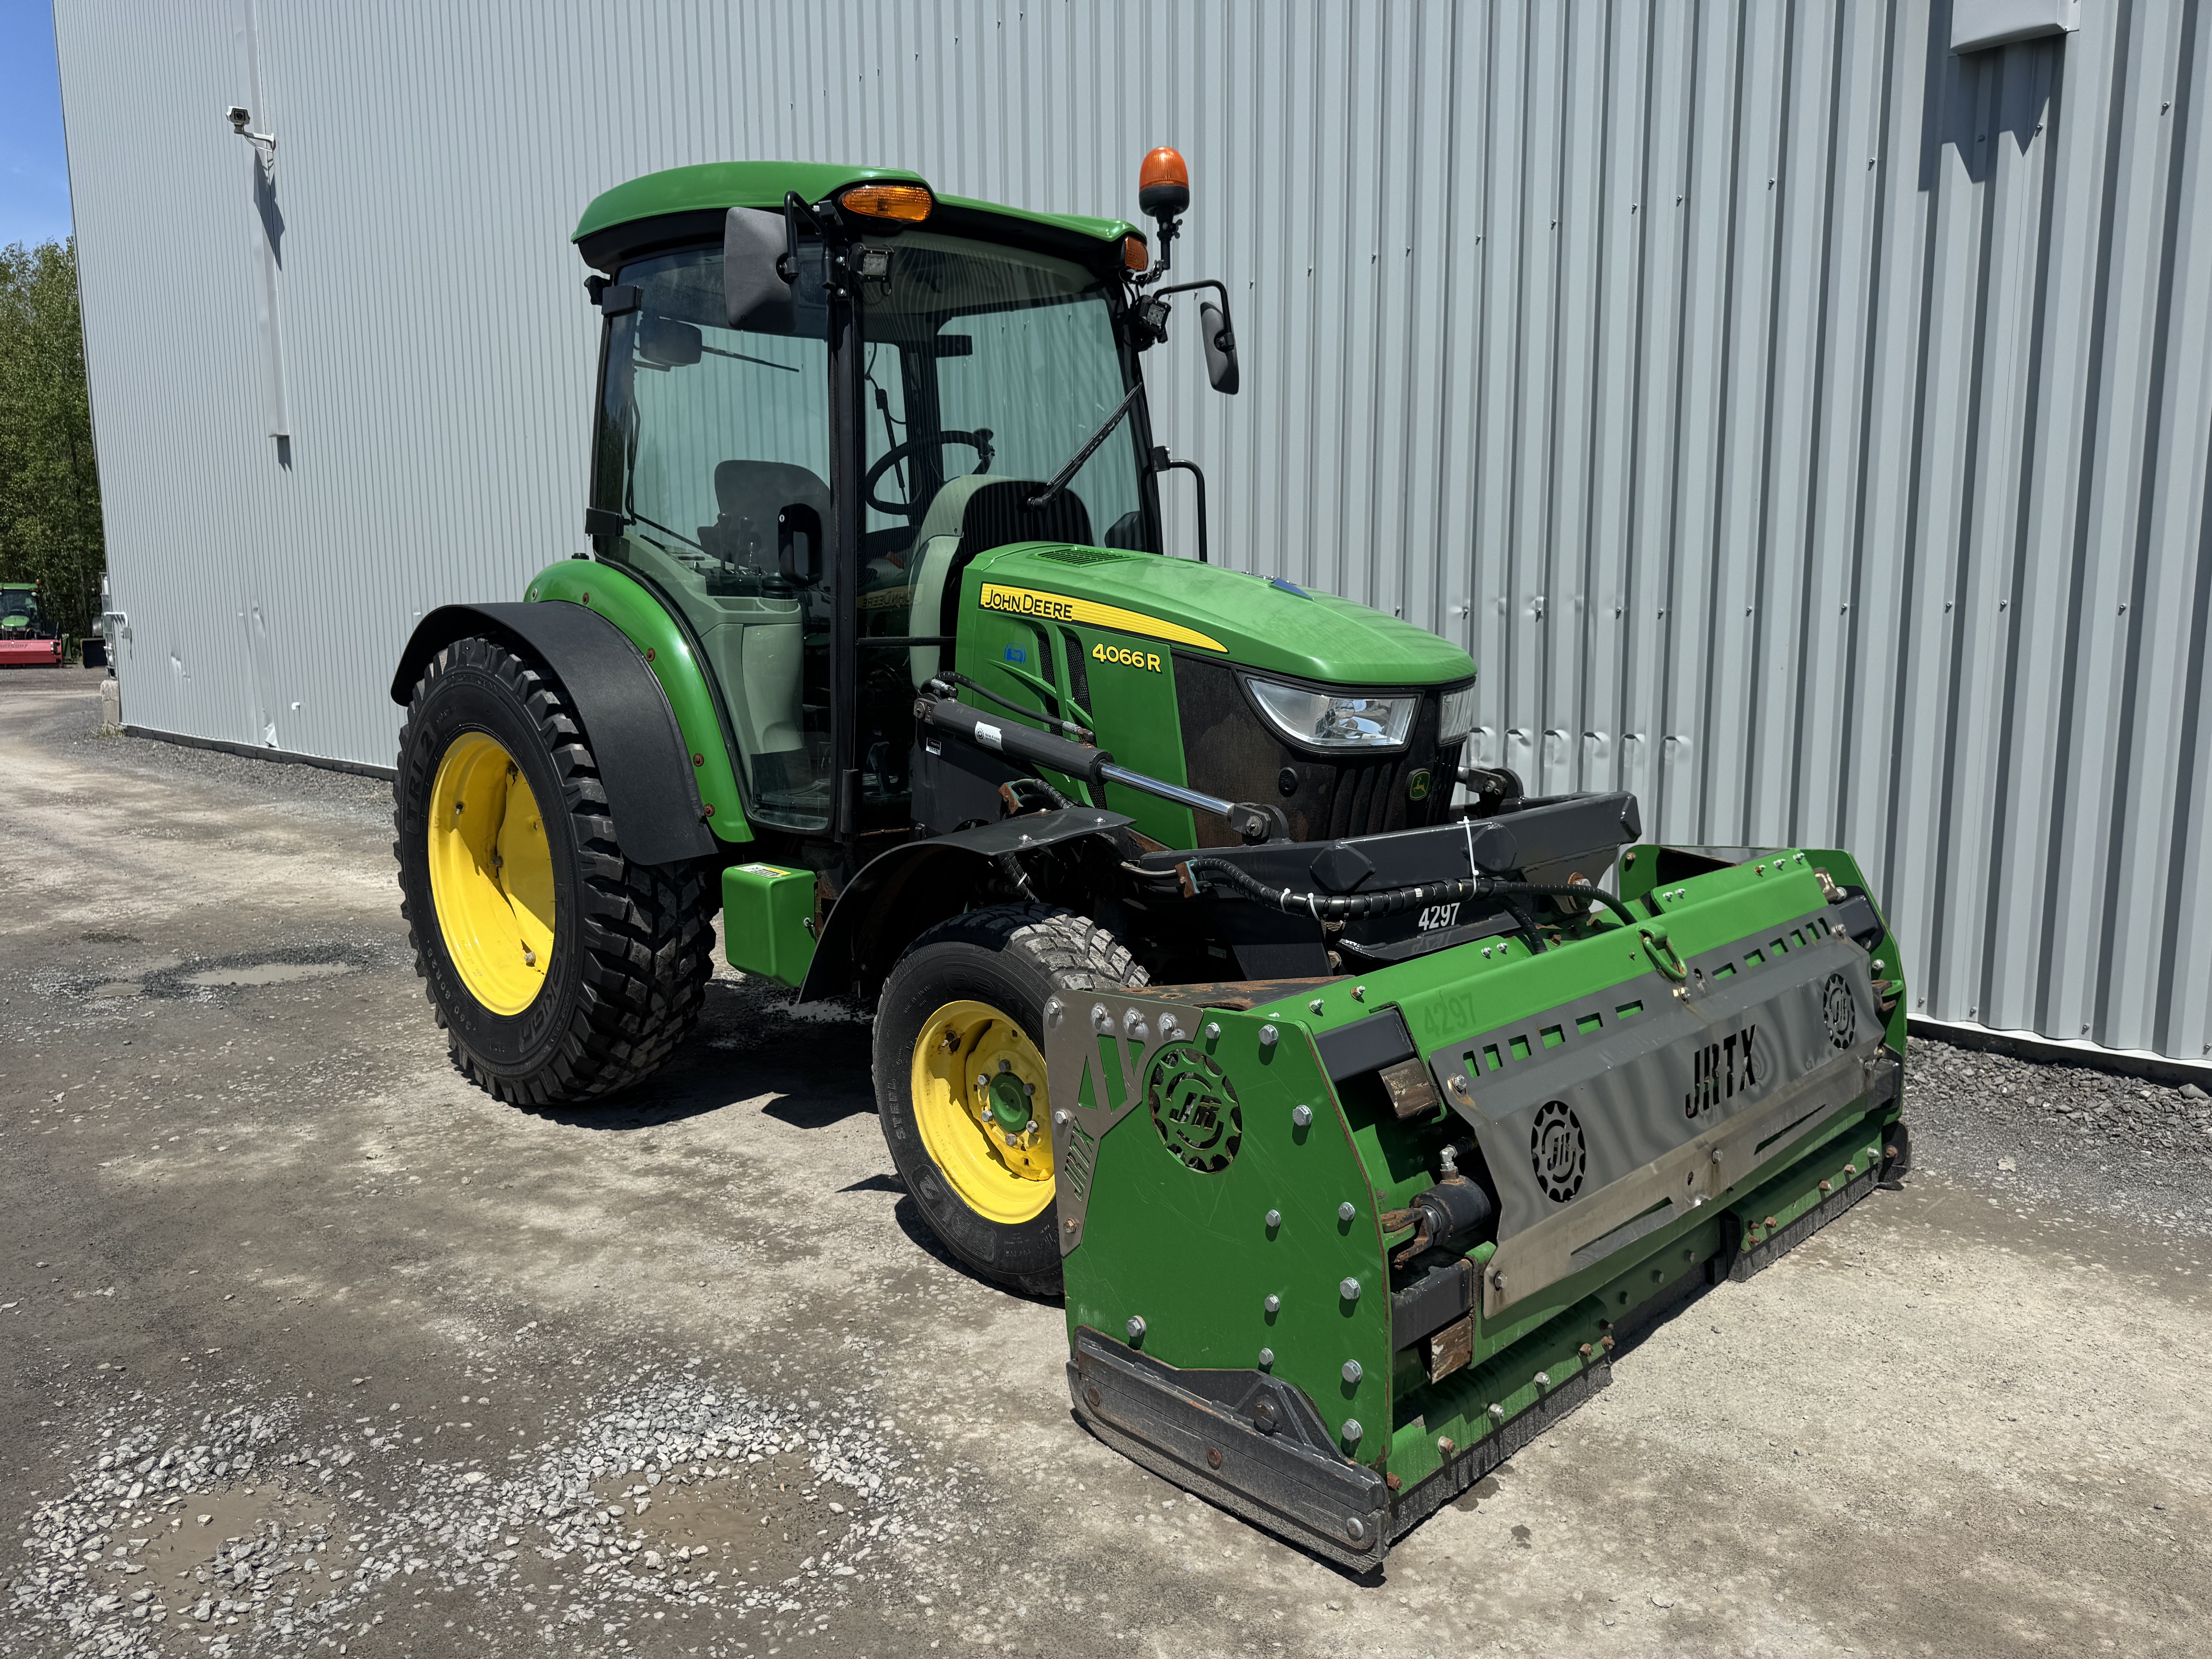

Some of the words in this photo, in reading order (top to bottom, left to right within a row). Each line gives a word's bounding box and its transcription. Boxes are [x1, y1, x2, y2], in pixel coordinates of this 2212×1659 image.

[985, 589, 1020, 611] JOHN
[1022, 594, 1073, 619] DEERE
[1092, 643, 1162, 673] 4066R
[1419, 902, 1460, 931] 4297
[1424, 992, 1477, 1038] 4297
[1685, 1024, 1757, 1119] JRTX
